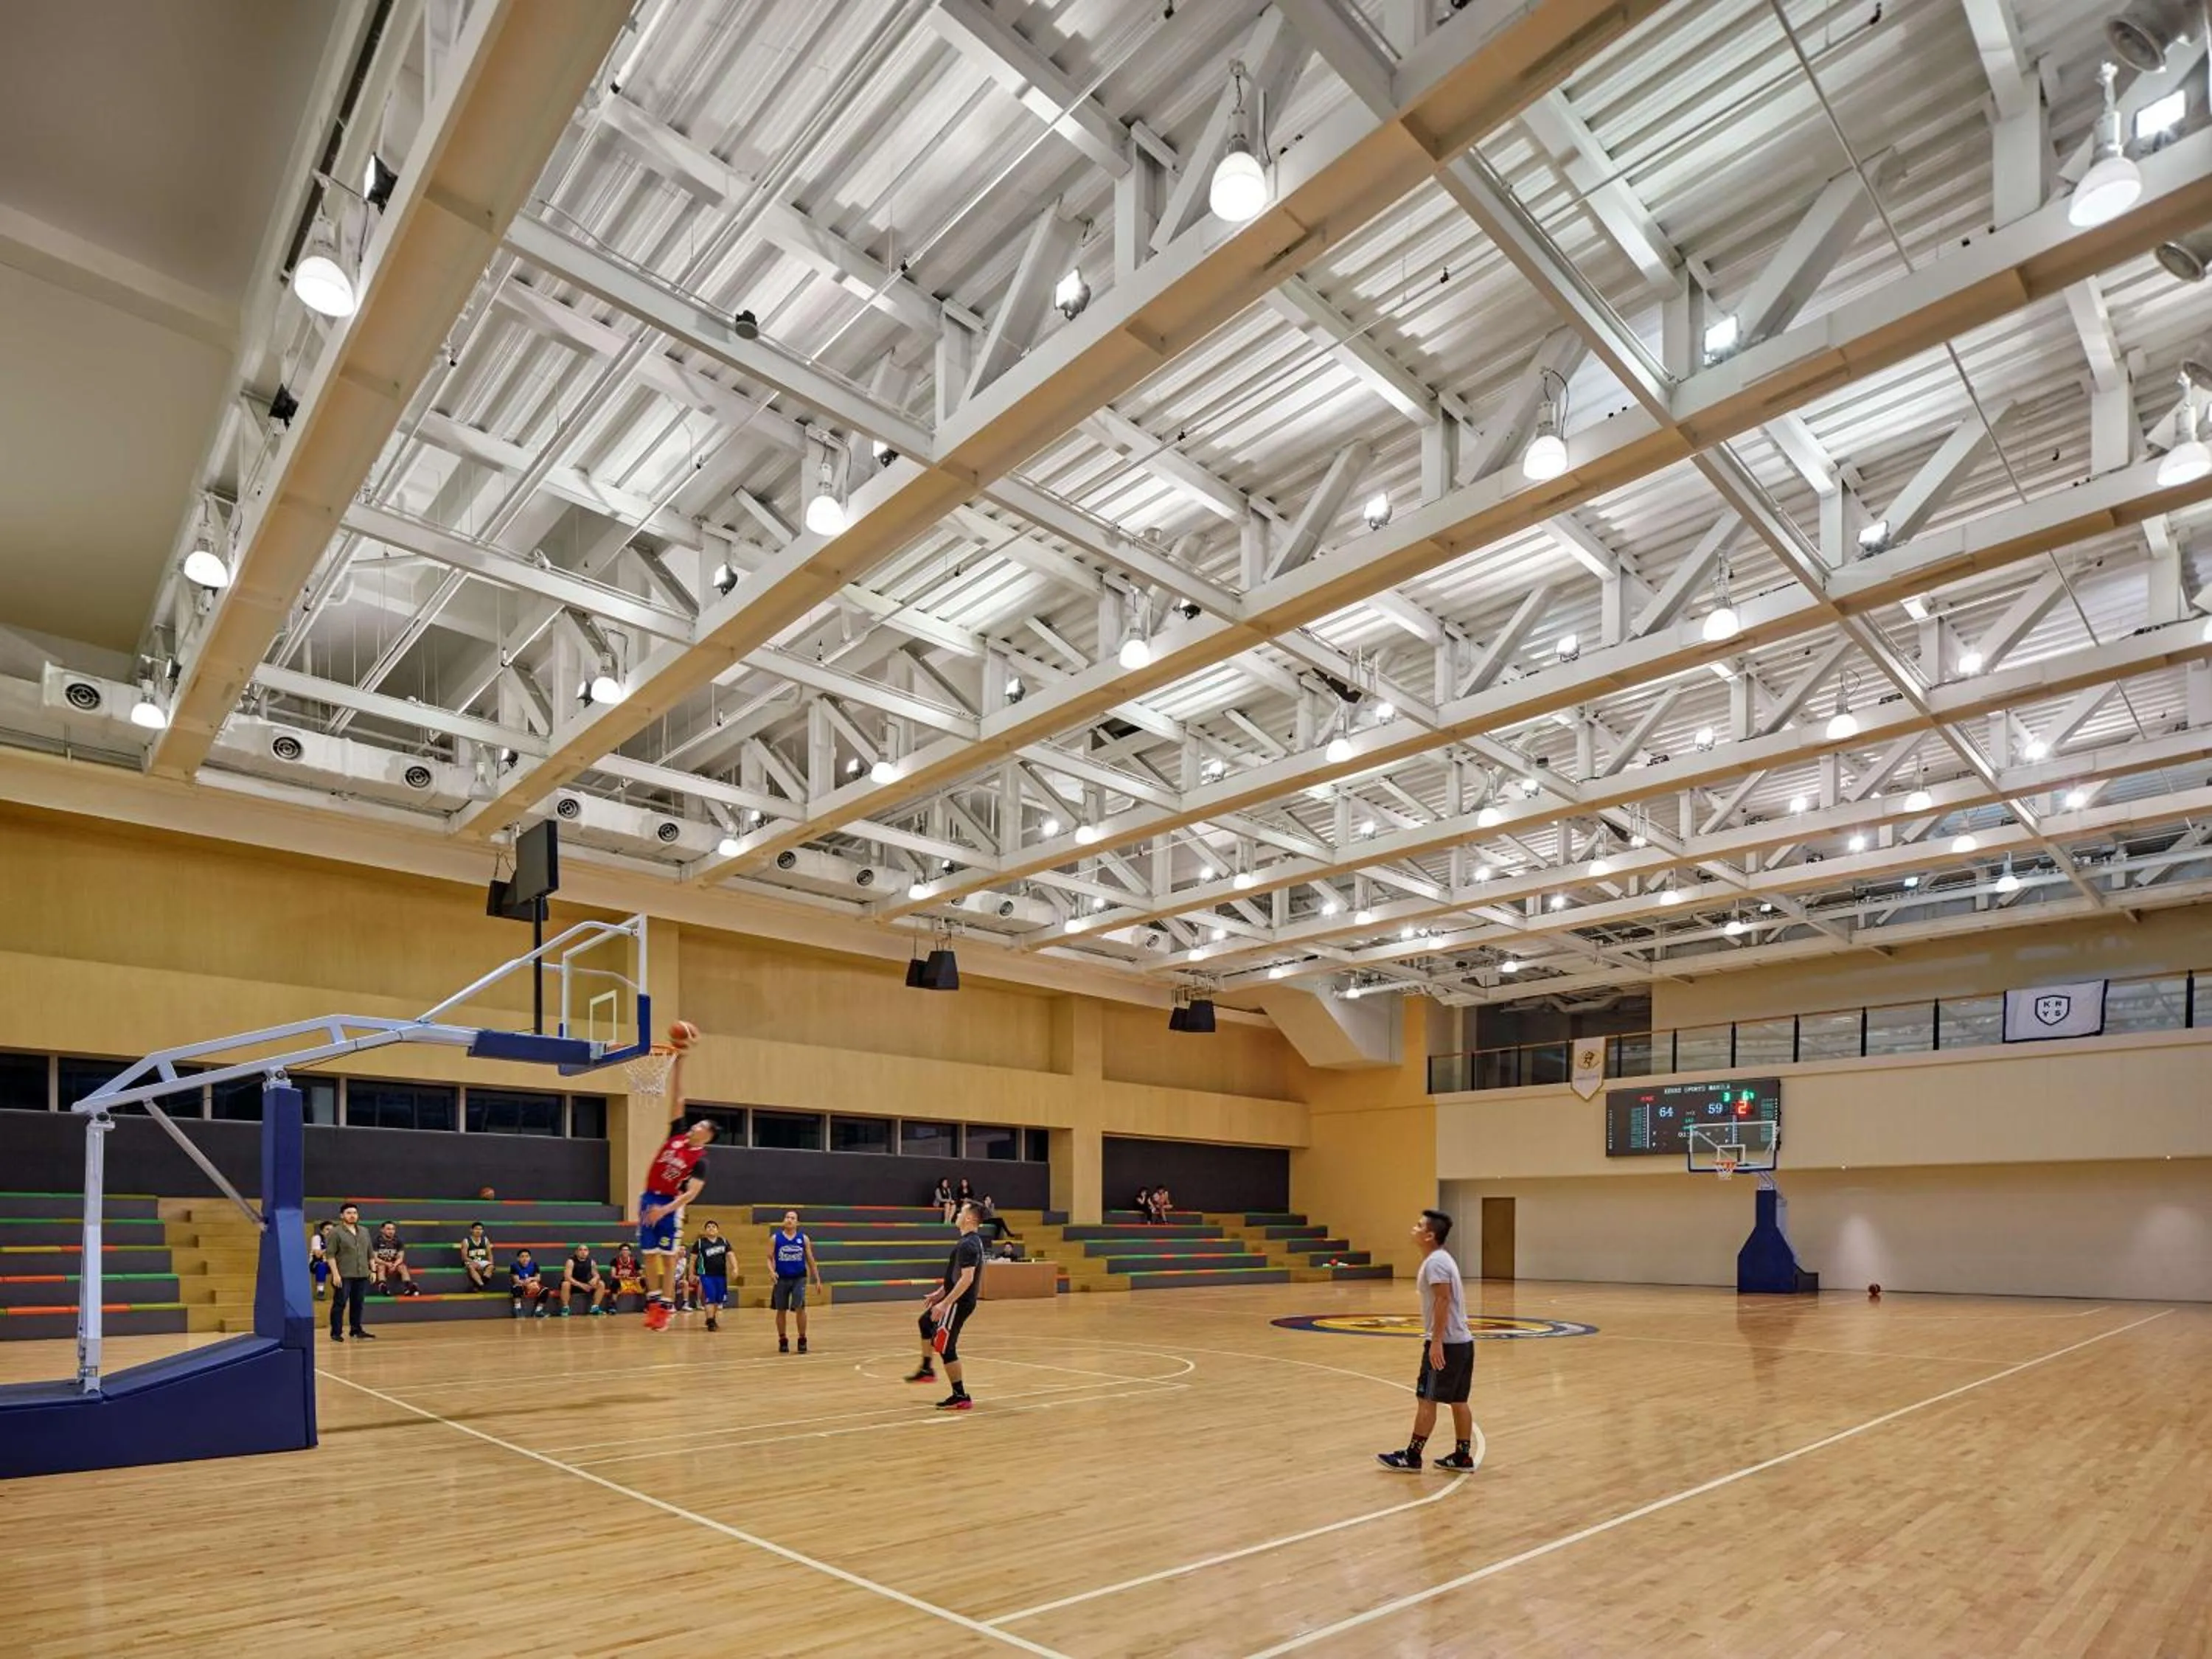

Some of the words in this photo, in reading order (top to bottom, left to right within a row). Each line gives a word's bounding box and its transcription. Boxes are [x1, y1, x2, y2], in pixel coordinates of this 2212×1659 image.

[1659, 1106, 1674, 1117] 64
[1708, 1102, 1723, 1114] 59
[1737, 1100, 1747, 1114] 2
